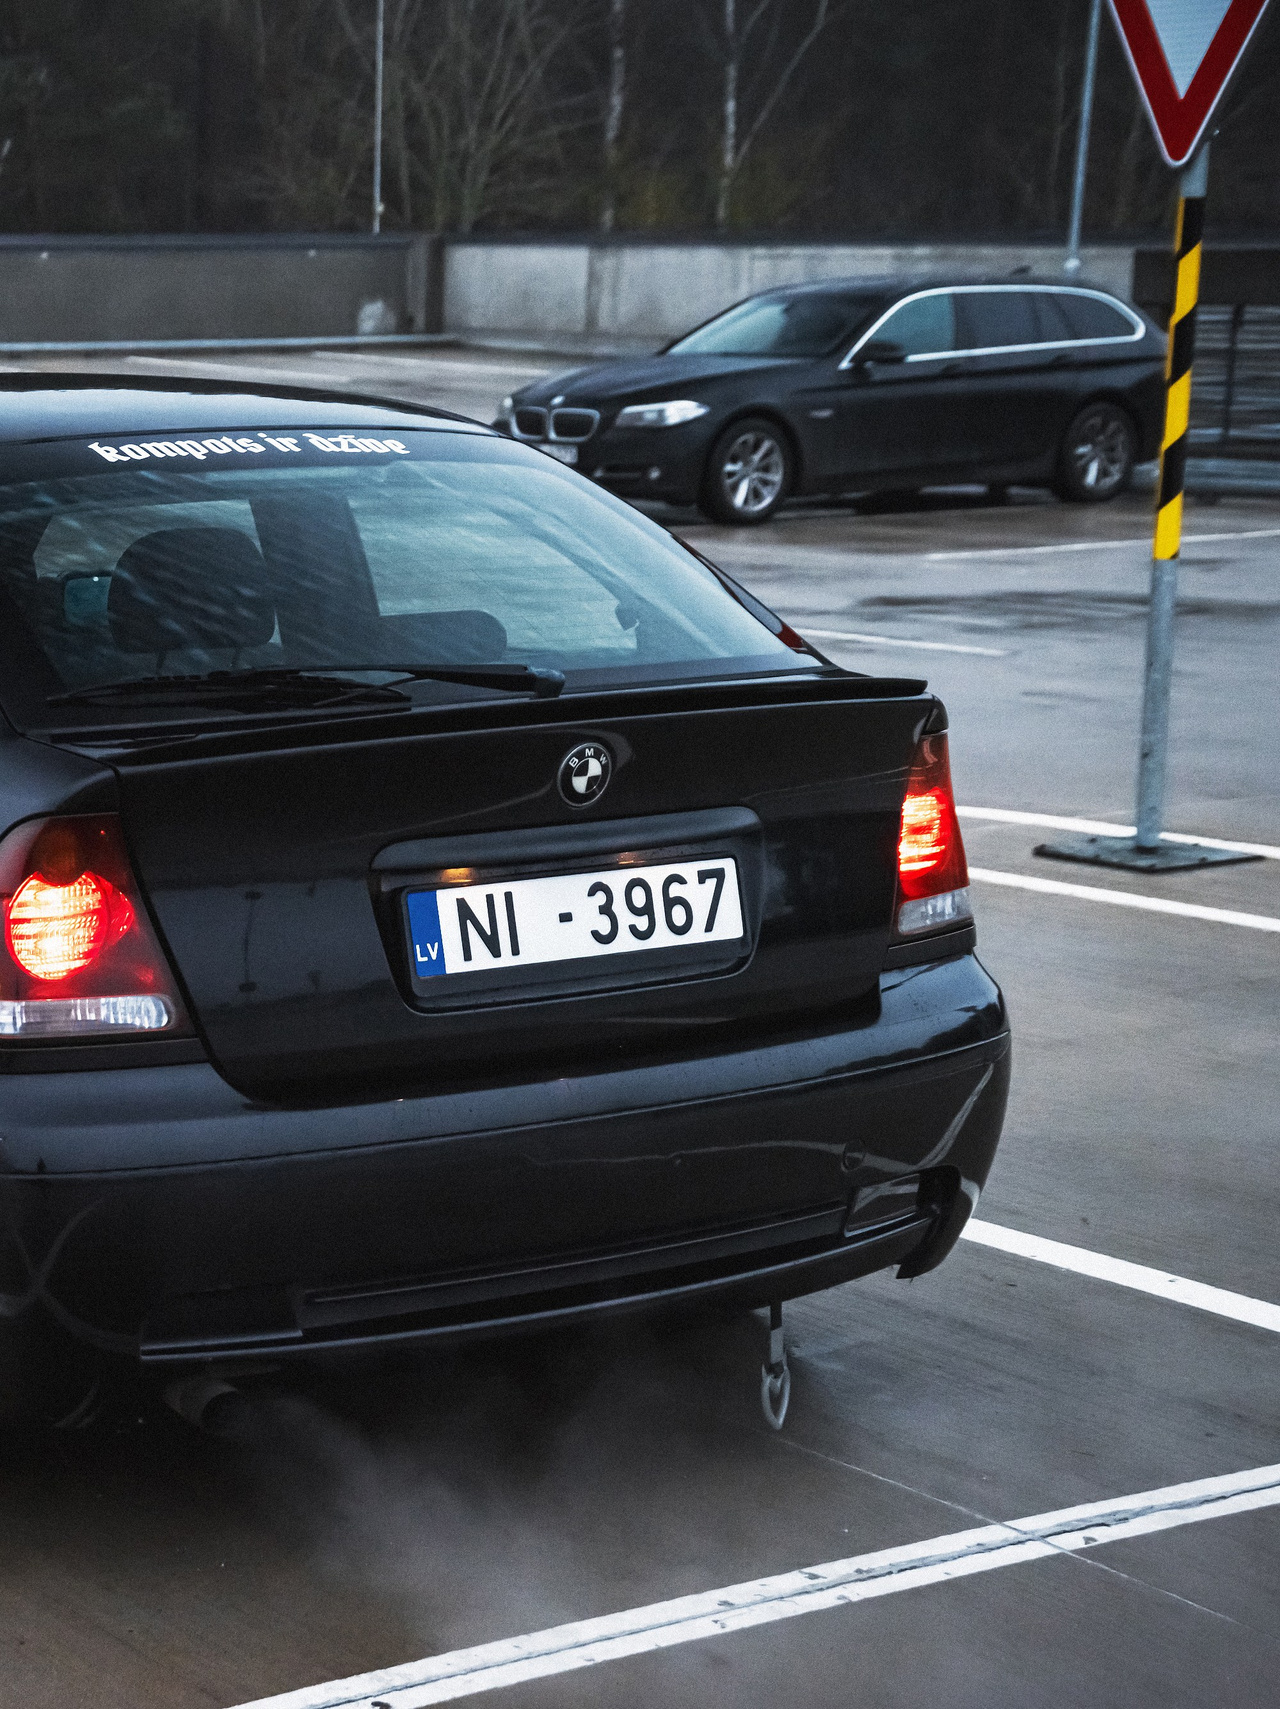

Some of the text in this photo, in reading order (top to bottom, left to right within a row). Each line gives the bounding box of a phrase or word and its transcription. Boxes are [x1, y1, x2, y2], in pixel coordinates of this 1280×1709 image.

[87, 435, 266, 463] kompots
[257, 432, 302, 452] ir
[568, 747, 608, 768] BMW
[415, 942, 439, 962] LV
